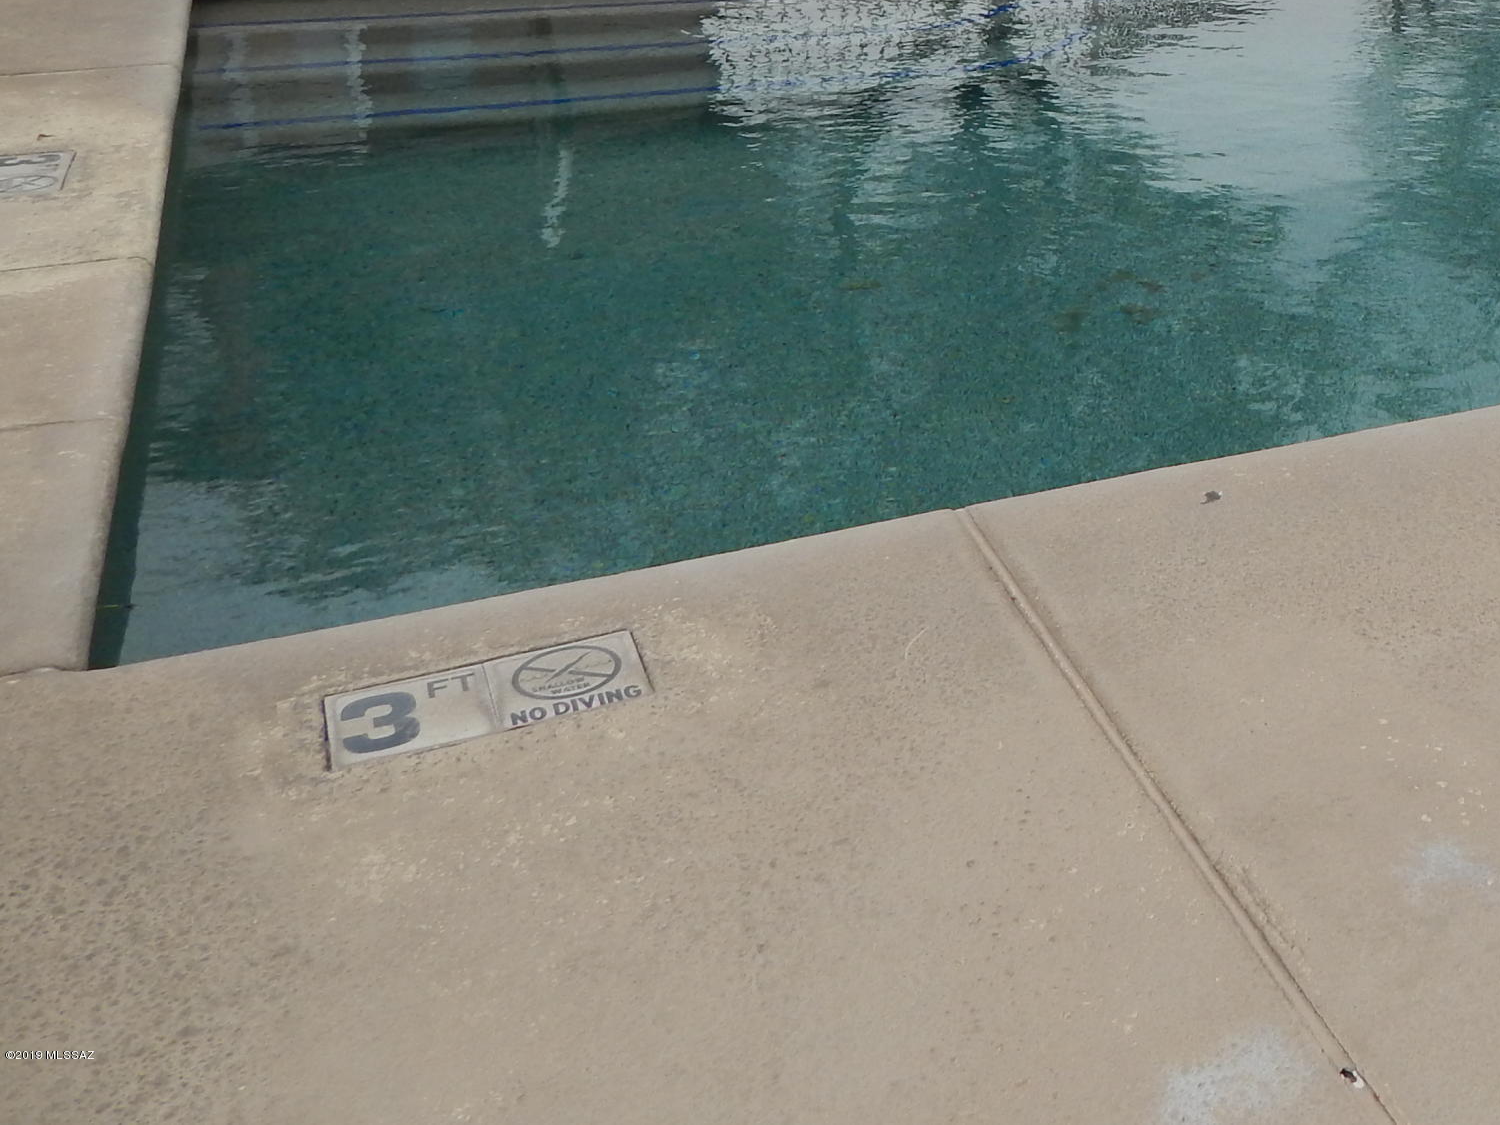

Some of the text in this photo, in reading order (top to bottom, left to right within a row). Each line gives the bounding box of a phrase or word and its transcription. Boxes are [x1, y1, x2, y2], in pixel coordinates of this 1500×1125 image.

[510, 684, 642, 726] NO DIVING
[550, 682, 591, 694] WATER
[340, 672, 475, 754] 3 FT
